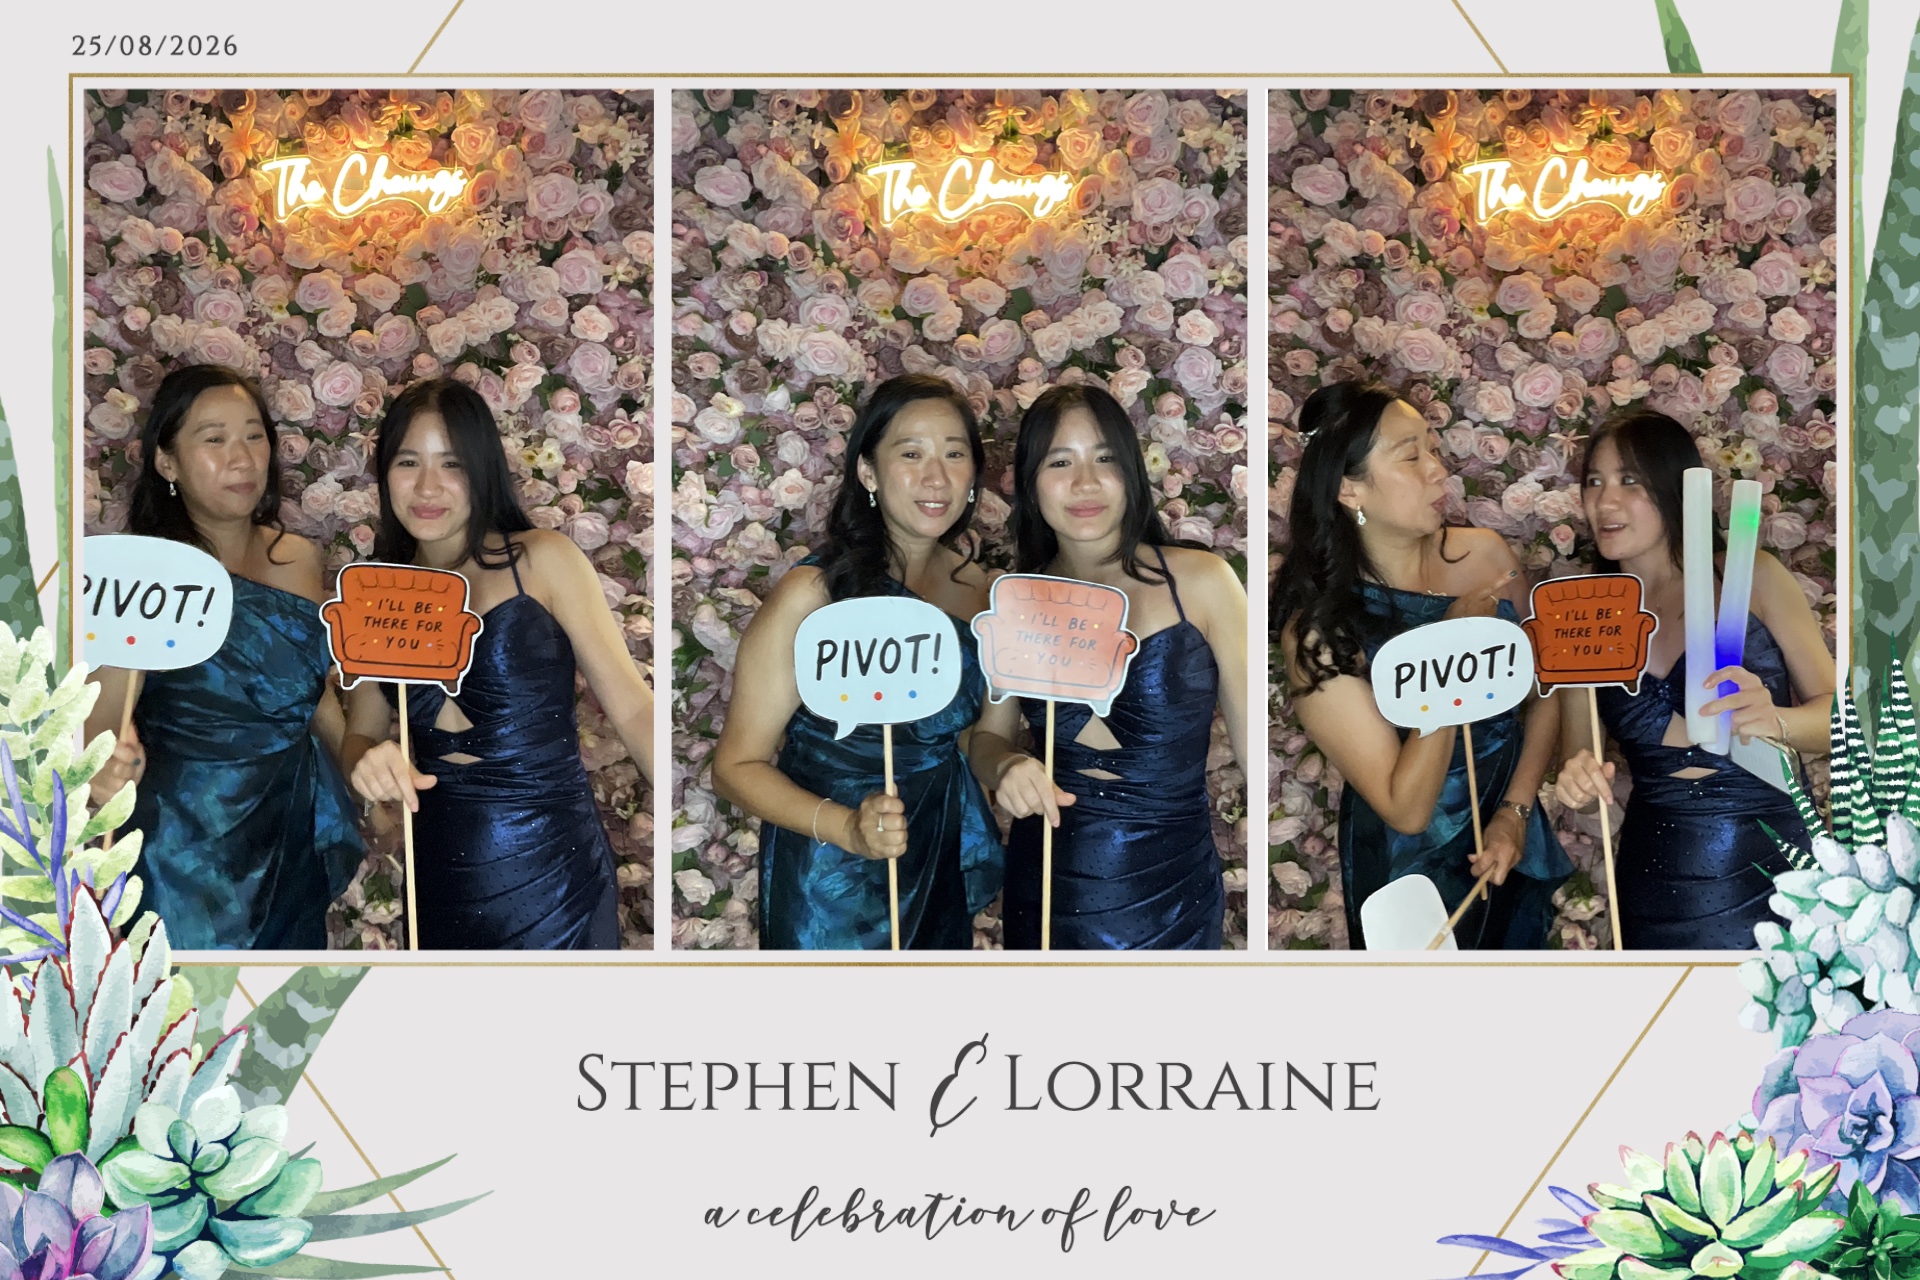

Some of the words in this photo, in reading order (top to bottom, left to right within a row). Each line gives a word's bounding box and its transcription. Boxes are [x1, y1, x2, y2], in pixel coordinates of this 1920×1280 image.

[261, 157, 327, 217] The
[867, 162, 932, 222] The
[1463, 160, 1527, 221] The
[377, 598, 406, 612] I'LL
[413, 601, 434, 615] BE
[1564, 609, 1589, 622] I'LL
[1595, 607, 1613, 620] BE
[363, 615, 409, 631] THERE
[416, 619, 443, 633] FOR
[1031, 612, 1060, 627] I'LL
[1067, 617, 1089, 631] BE
[1016, 629, 1063, 647] THERE
[1069, 636, 1097, 651] FOR
[1553, 627, 1592, 639] THERE
[1598, 624, 1623, 637] FOR
[385, 635, 421, 650] YOU
[1571, 644, 1603, 657] YOU
[815, 632, 943, 681] PIVOT!
[1037, 651, 1072, 667] YOU
[1394, 642, 1516, 699] PIVOT!
